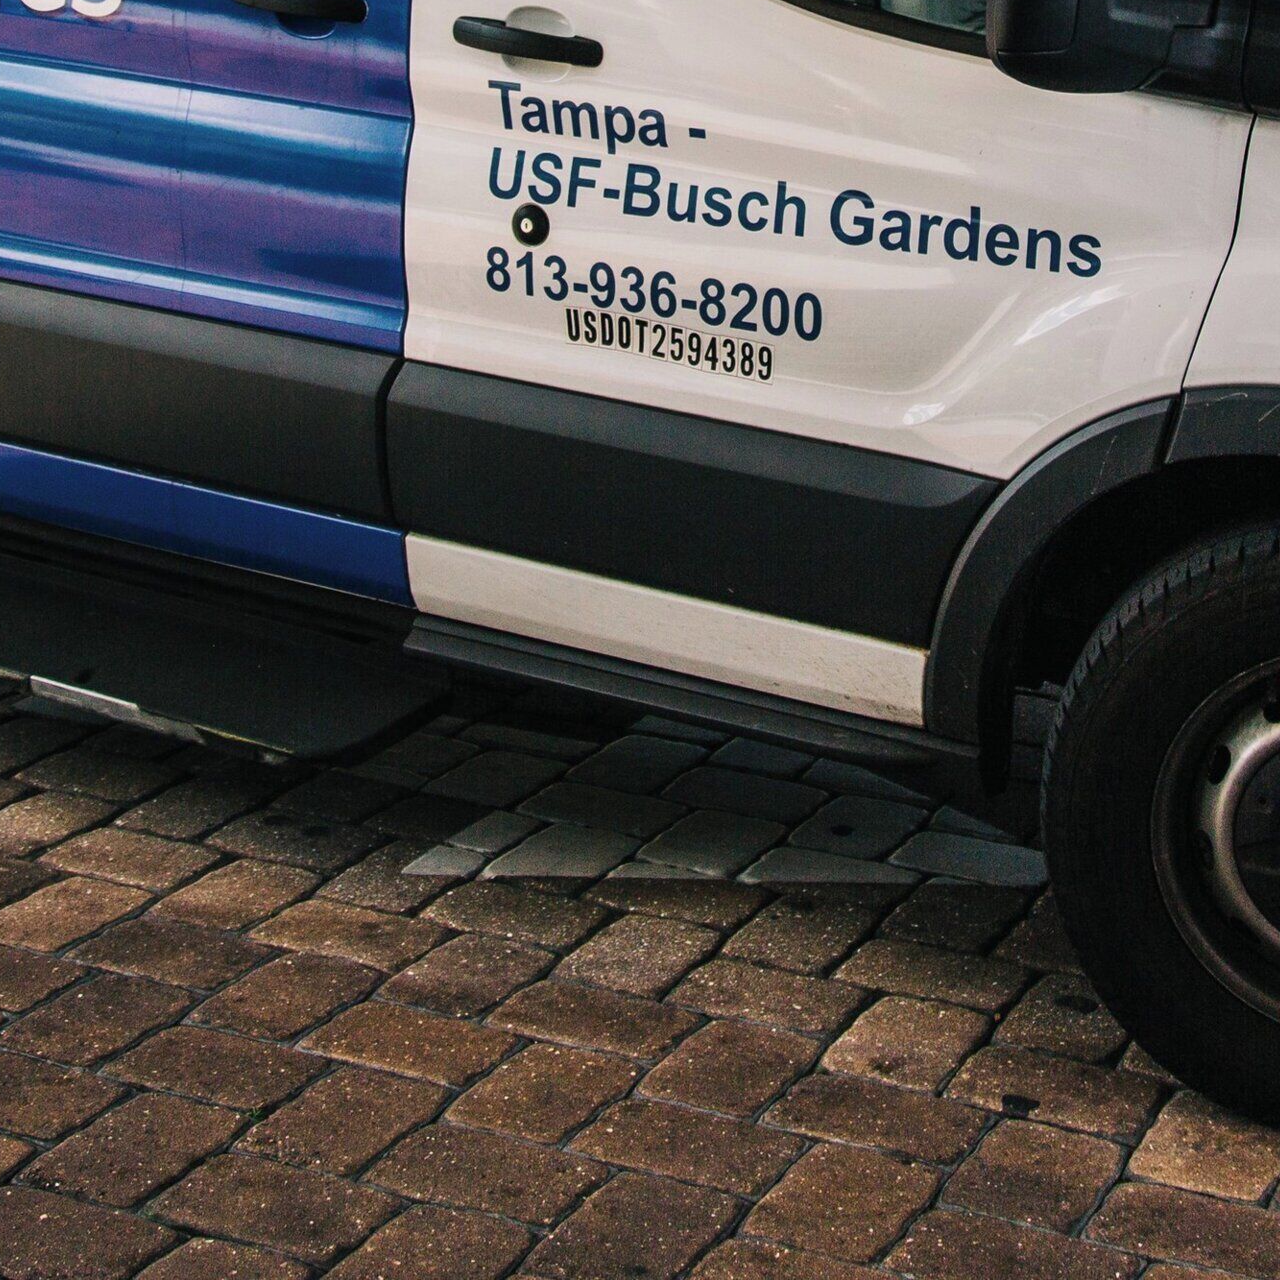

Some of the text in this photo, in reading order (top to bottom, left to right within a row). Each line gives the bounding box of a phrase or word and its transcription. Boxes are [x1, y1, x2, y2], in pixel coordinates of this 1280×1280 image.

[488, 79, 669, 155] Tampa
[488, 146, 1103, 278] USF-Busch Gardens
[485, 246, 823, 342] 813-936-8200
[564, 306, 774, 383] USDOT2594389
